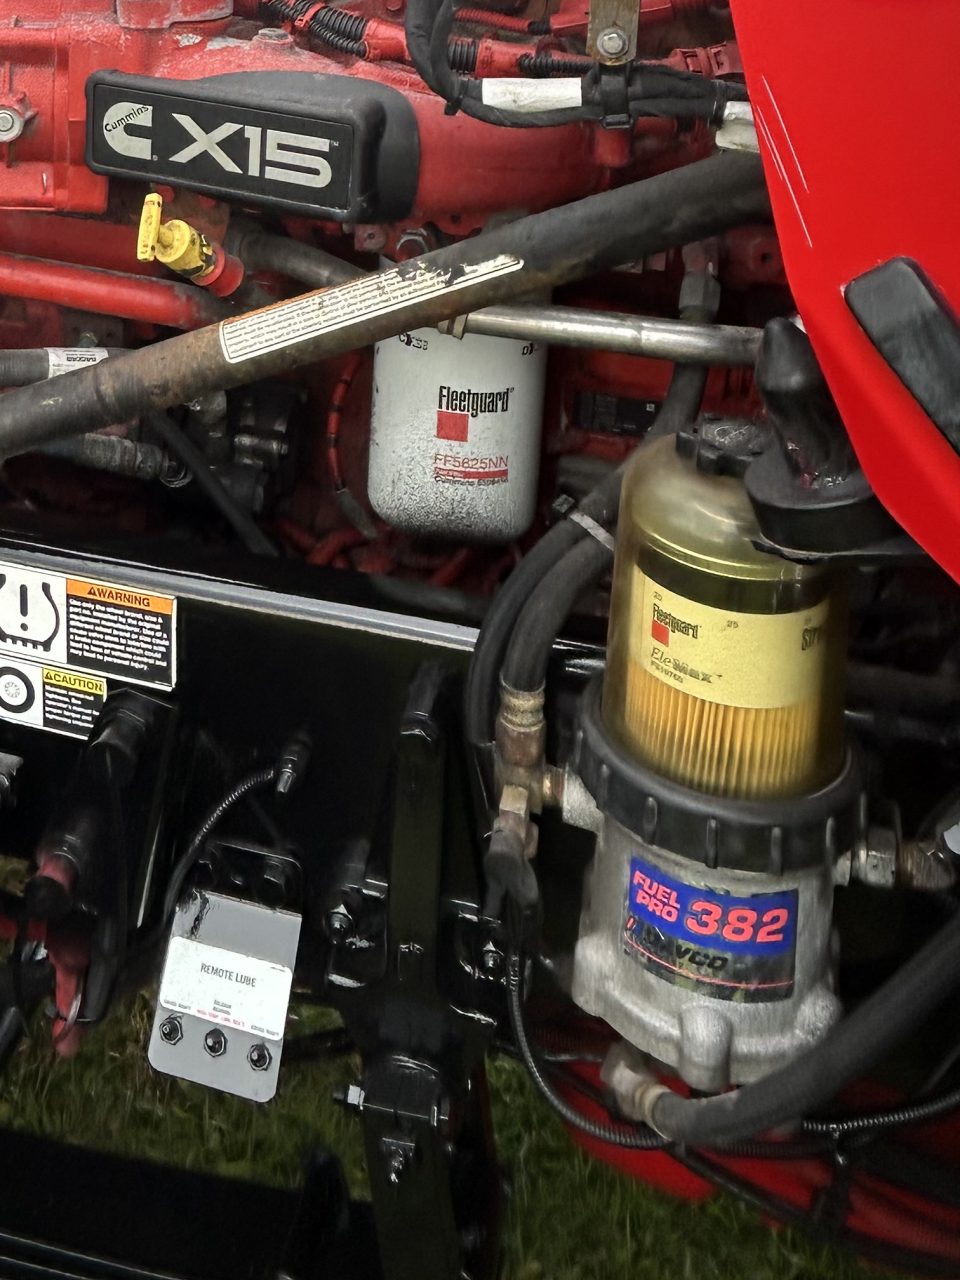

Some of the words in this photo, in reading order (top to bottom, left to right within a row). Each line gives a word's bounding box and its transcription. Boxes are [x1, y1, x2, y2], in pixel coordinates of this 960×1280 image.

[104, 105, 150, 132] Cummins
[168, 113, 332, 188] X15
[439, 386, 510, 418] Fleetguard
[97, 588, 151, 607] WARNING
[54, 674, 102, 692] CAUTION
[633, 870, 680, 908] FUEL
[636, 889, 679, 922] PRO
[686, 900, 789, 943] 382
[201, 963, 233, 981] REMOTE
[236, 973, 257, 988] LUBE
